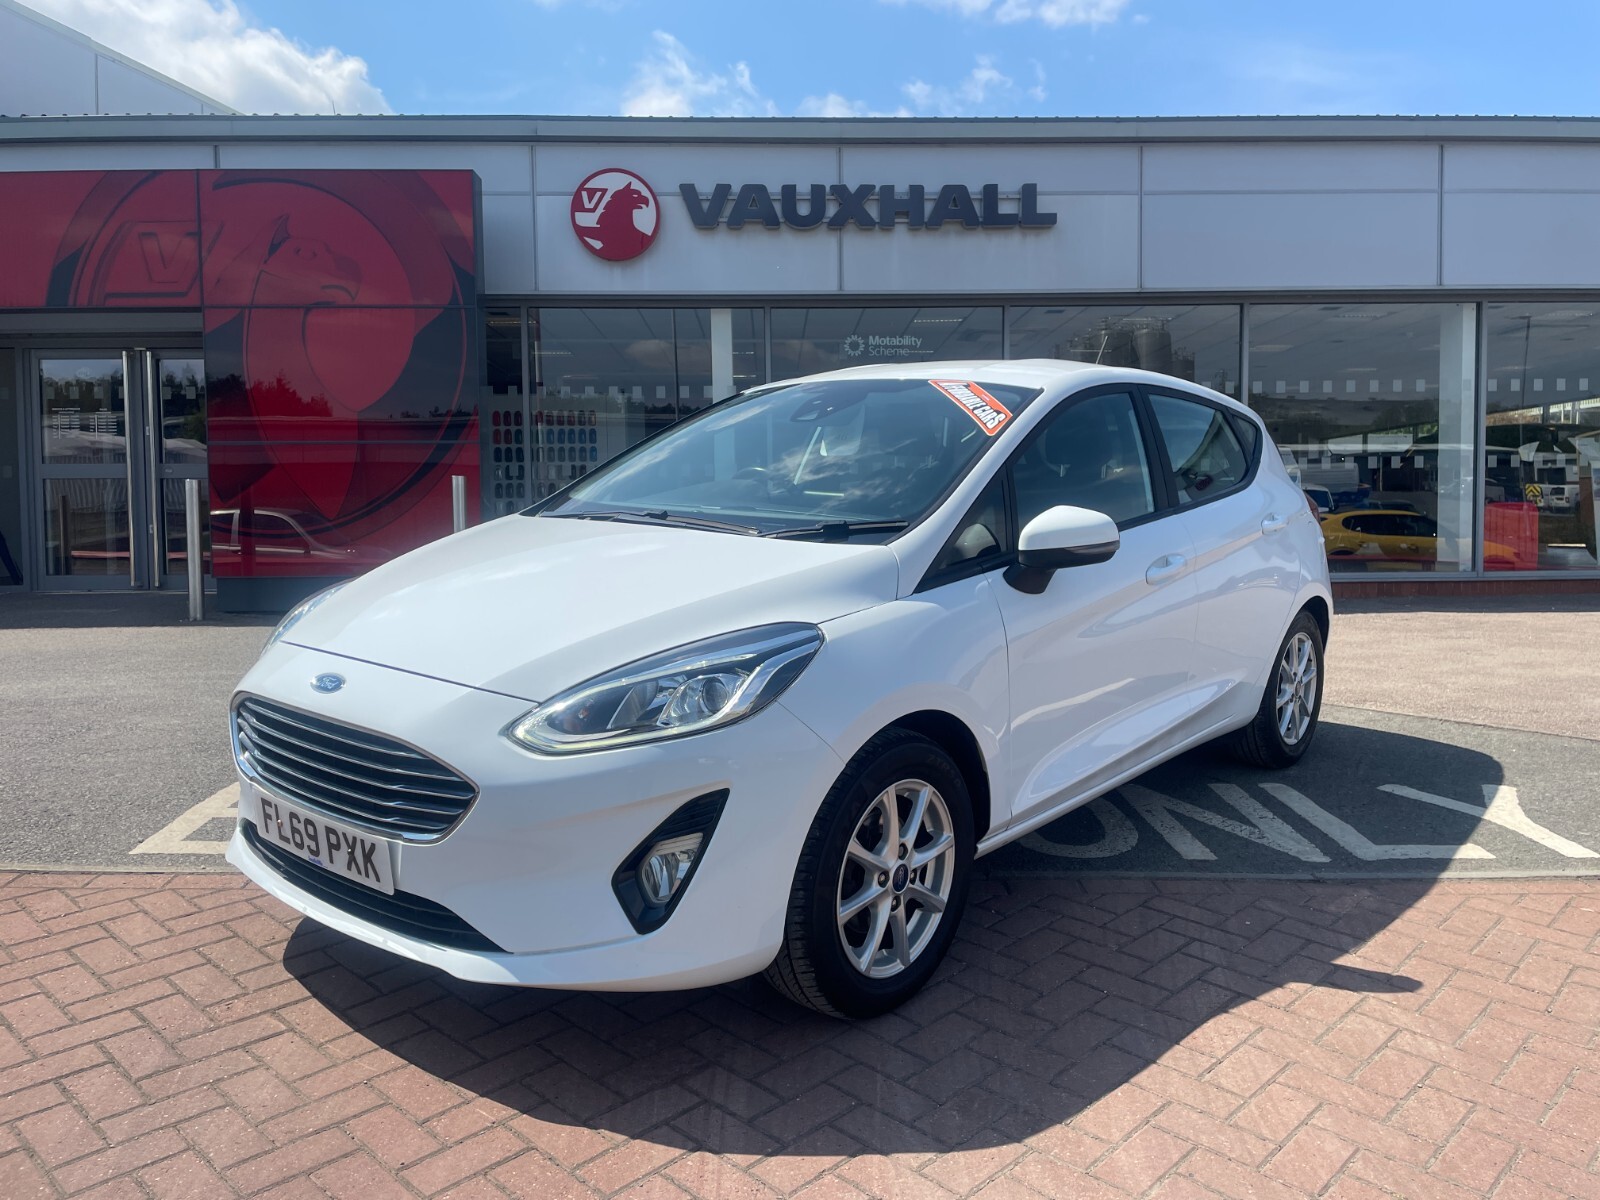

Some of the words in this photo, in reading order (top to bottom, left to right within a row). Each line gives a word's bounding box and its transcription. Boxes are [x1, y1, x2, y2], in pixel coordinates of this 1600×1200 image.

[679, 183, 1057, 230] VAUXHALL
[868, 335, 922, 349] Motability
[868, 346, 910, 357] Scheme
[260, 798, 320, 858] FL69
[325, 826, 381, 883] PXK
[1019, 782, 1600, 862] ONLY
